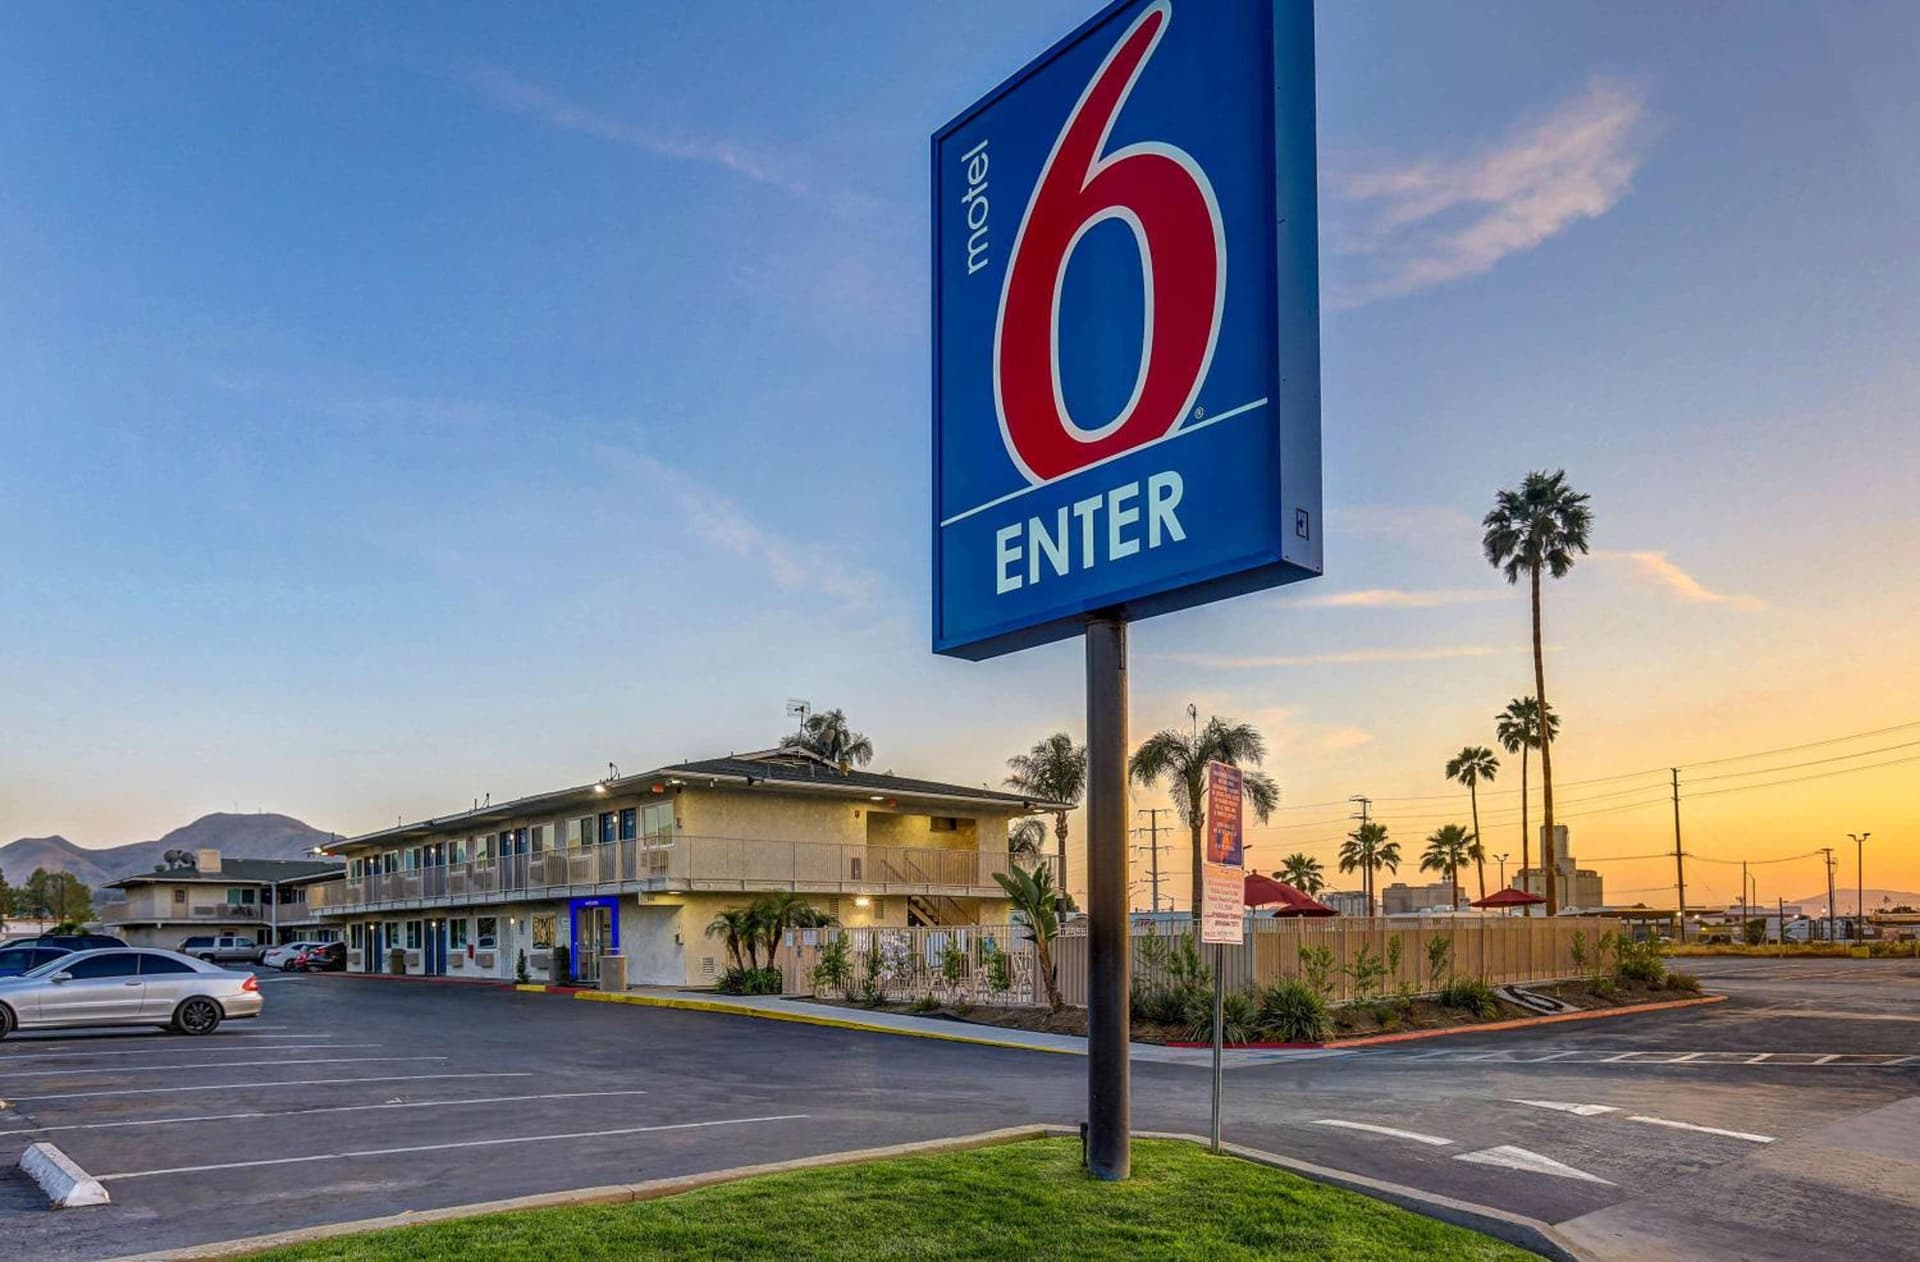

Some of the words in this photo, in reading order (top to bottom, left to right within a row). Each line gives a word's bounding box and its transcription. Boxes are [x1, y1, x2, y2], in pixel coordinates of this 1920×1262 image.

[961, 139, 989, 275] motel
[992, 0, 1227, 487] 6
[996, 470, 1187, 595] ENTER
